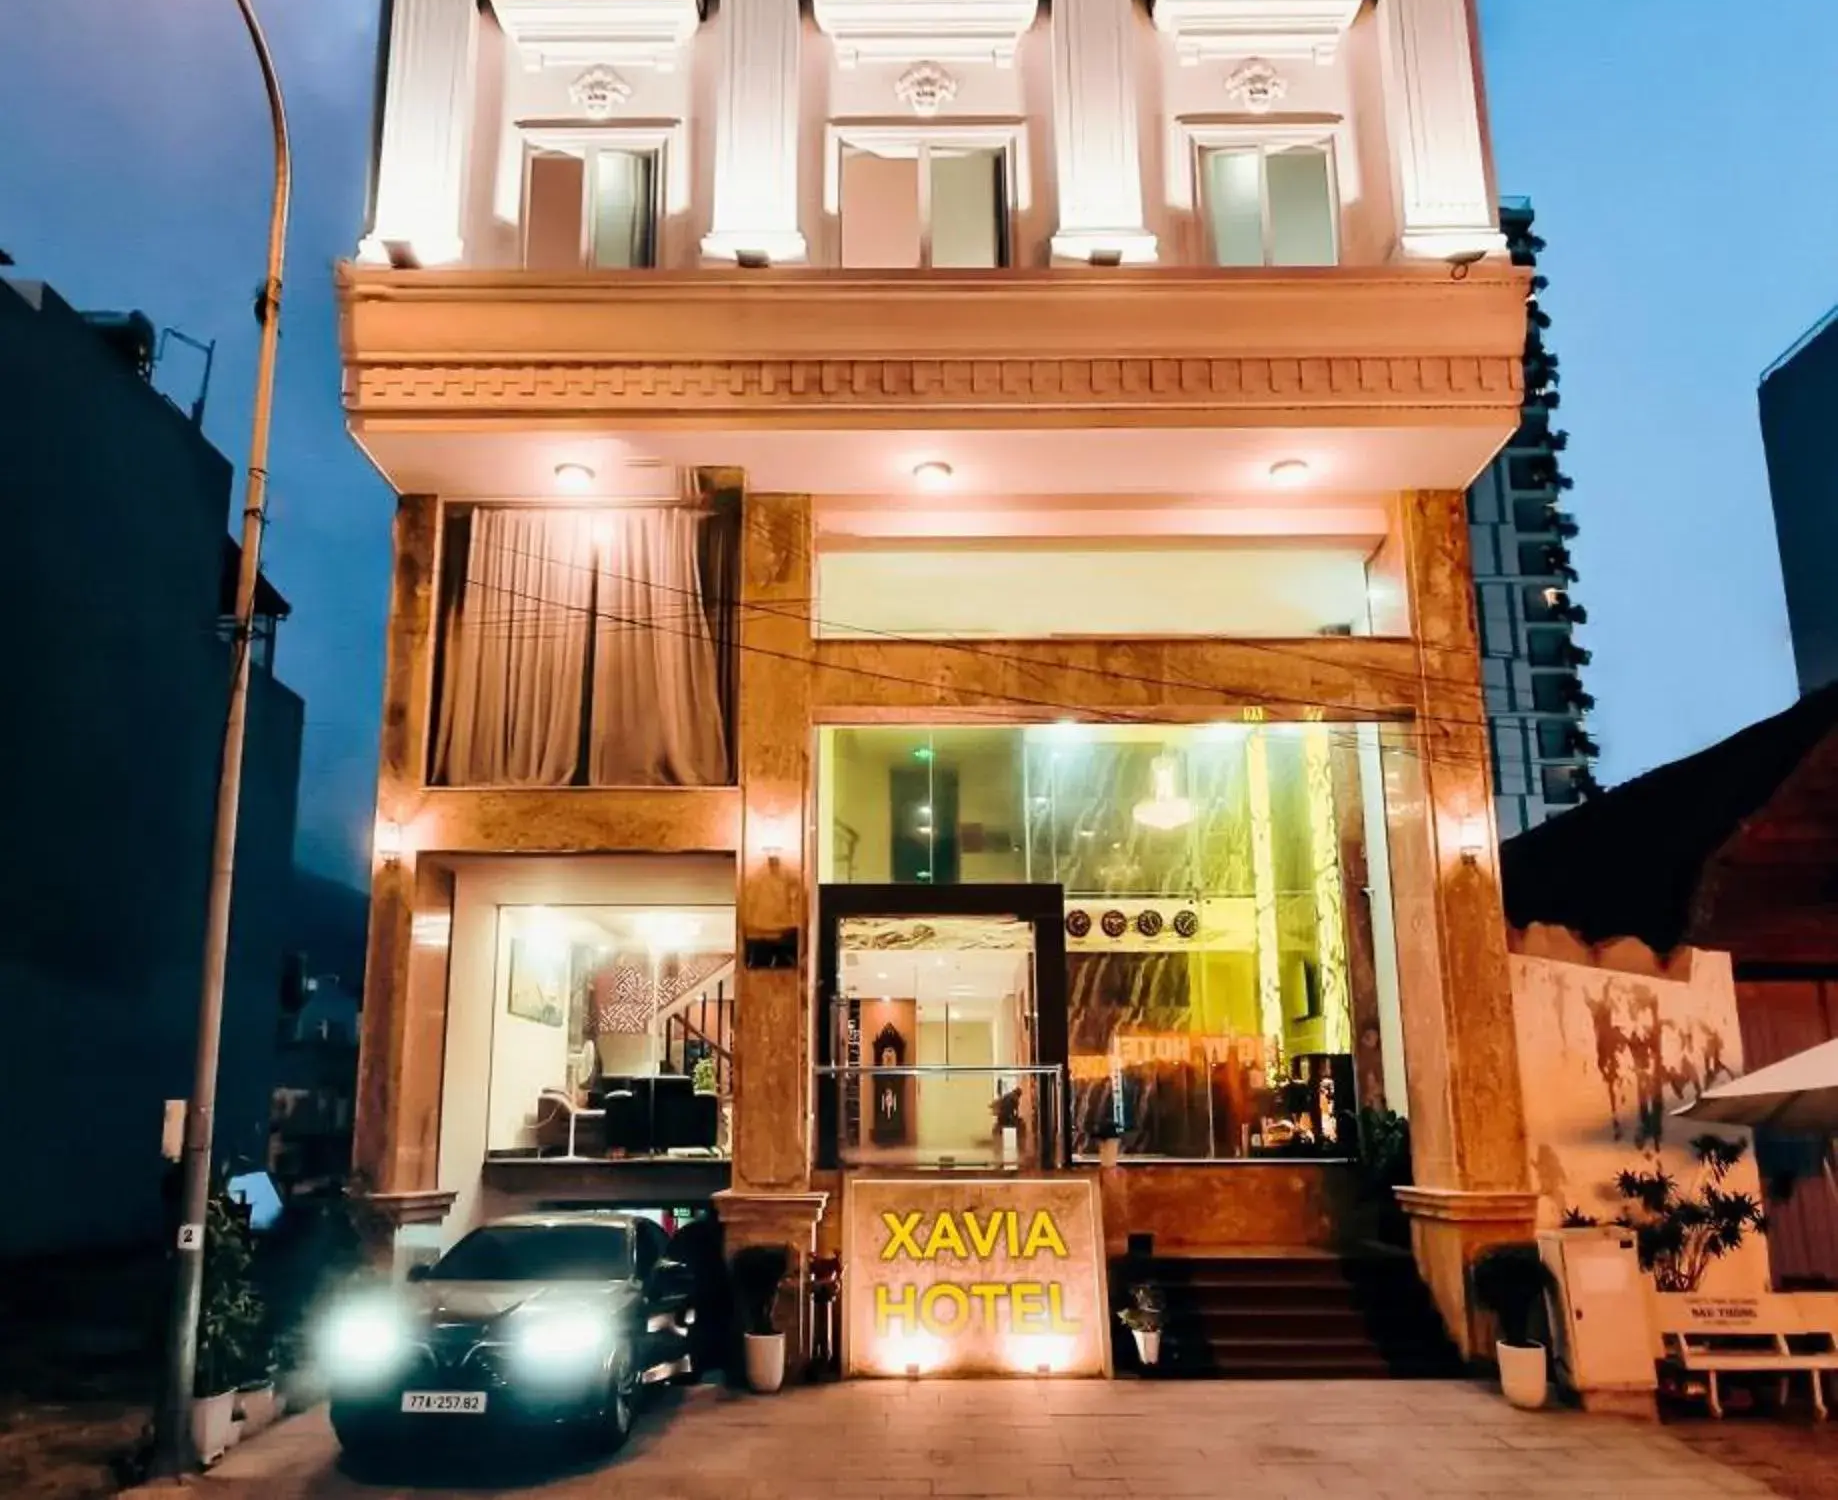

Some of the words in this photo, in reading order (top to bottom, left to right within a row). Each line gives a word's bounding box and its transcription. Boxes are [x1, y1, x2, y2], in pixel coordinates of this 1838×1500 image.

[183, 1228, 193, 1243] 2
[882, 1210, 1069, 1260] XAVIA
[875, 1283, 1083, 1337] HOTEL
